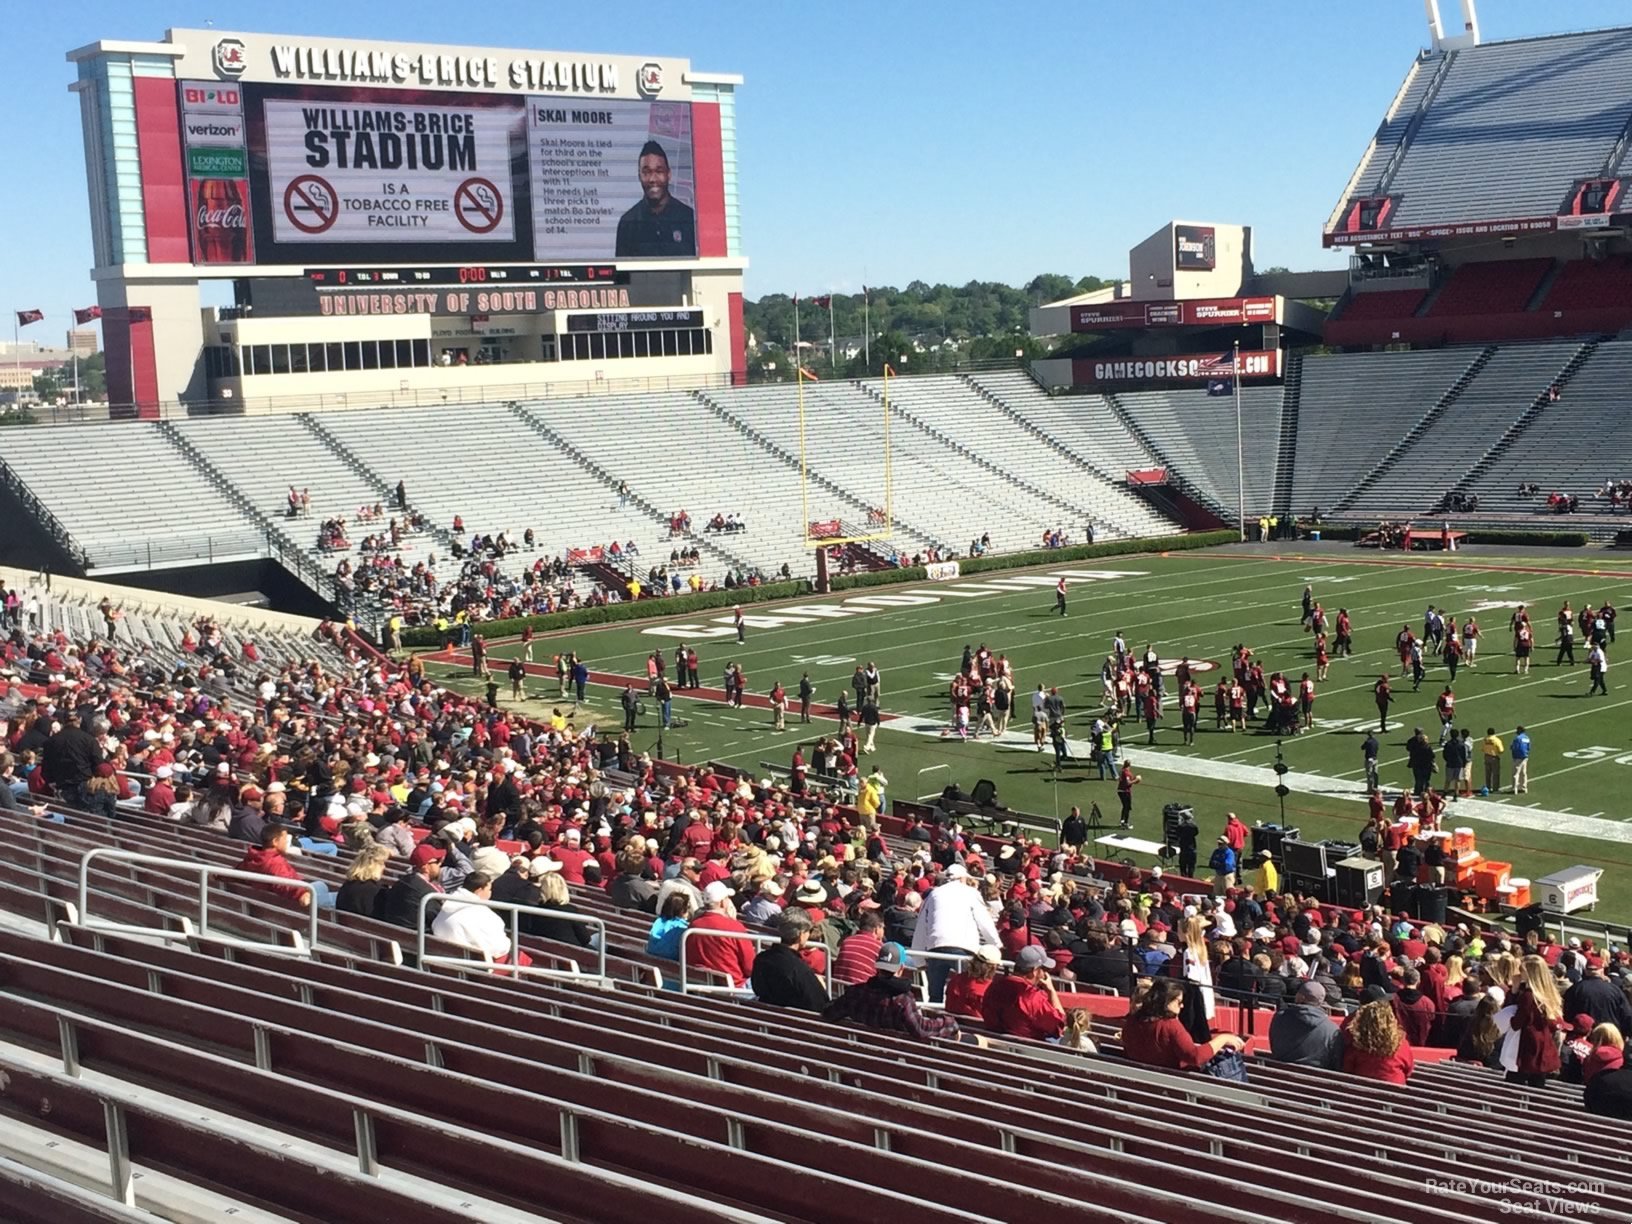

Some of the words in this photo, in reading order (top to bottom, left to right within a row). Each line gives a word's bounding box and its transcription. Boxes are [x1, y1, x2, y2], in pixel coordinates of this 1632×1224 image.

[271, 45, 497, 86] WILLIAMS-BRICE
[509, 60, 618, 92] STADIUM
[302, 108, 474, 135] WILLIAMS-BRICE
[538, 109, 567, 123] SKAI
[572, 110, 613, 124] MOORE
[188, 124, 236, 136] verizon
[560, 139, 585, 148] Moore
[588, 139, 594, 148] is
[596, 140, 612, 148] tied
[304, 130, 477, 171] STADIUM
[541, 148, 553, 156] for
[555, 149, 575, 157] third
[589, 149, 602, 157] the
[193, 155, 242, 166] LEXINGTON
[542, 168, 595, 177] interceptions
[383, 183, 395, 195] IS
[400, 183, 409, 195] A
[557, 188, 581, 196] needs
[583, 188, 598, 197] just
[343, 198, 411, 211] TOBACCO
[416, 200, 449, 211] FREE
[543, 197, 565, 205] three
[568, 198, 589, 206] picks
[572, 207, 583, 215] Bo
[368, 215, 428, 227] FACILITY
[545, 226, 554, 234] of
[1390, 231, 1403, 239] TEXT
[1475, 225, 1488, 233] AND
[1490, 223, 1519, 232] LOCATION
[320, 295, 438, 315] UNIVERSITY
[446, 293, 469, 313] OF
[478, 291, 537, 311] SOUTH
[544, 288, 630, 310] CAROLINA
[597, 313, 627, 322] SITTING
[631, 313, 657, 321] AROUND
[661, 312, 674, 320] YOU
[676, 311, 690, 320] AND
[597, 321, 628, 331] DISPLAY
[1095, 356, 1269, 380] GAMECOCKSOE.COM
[640, 569, 1151, 639] CAROLINA
